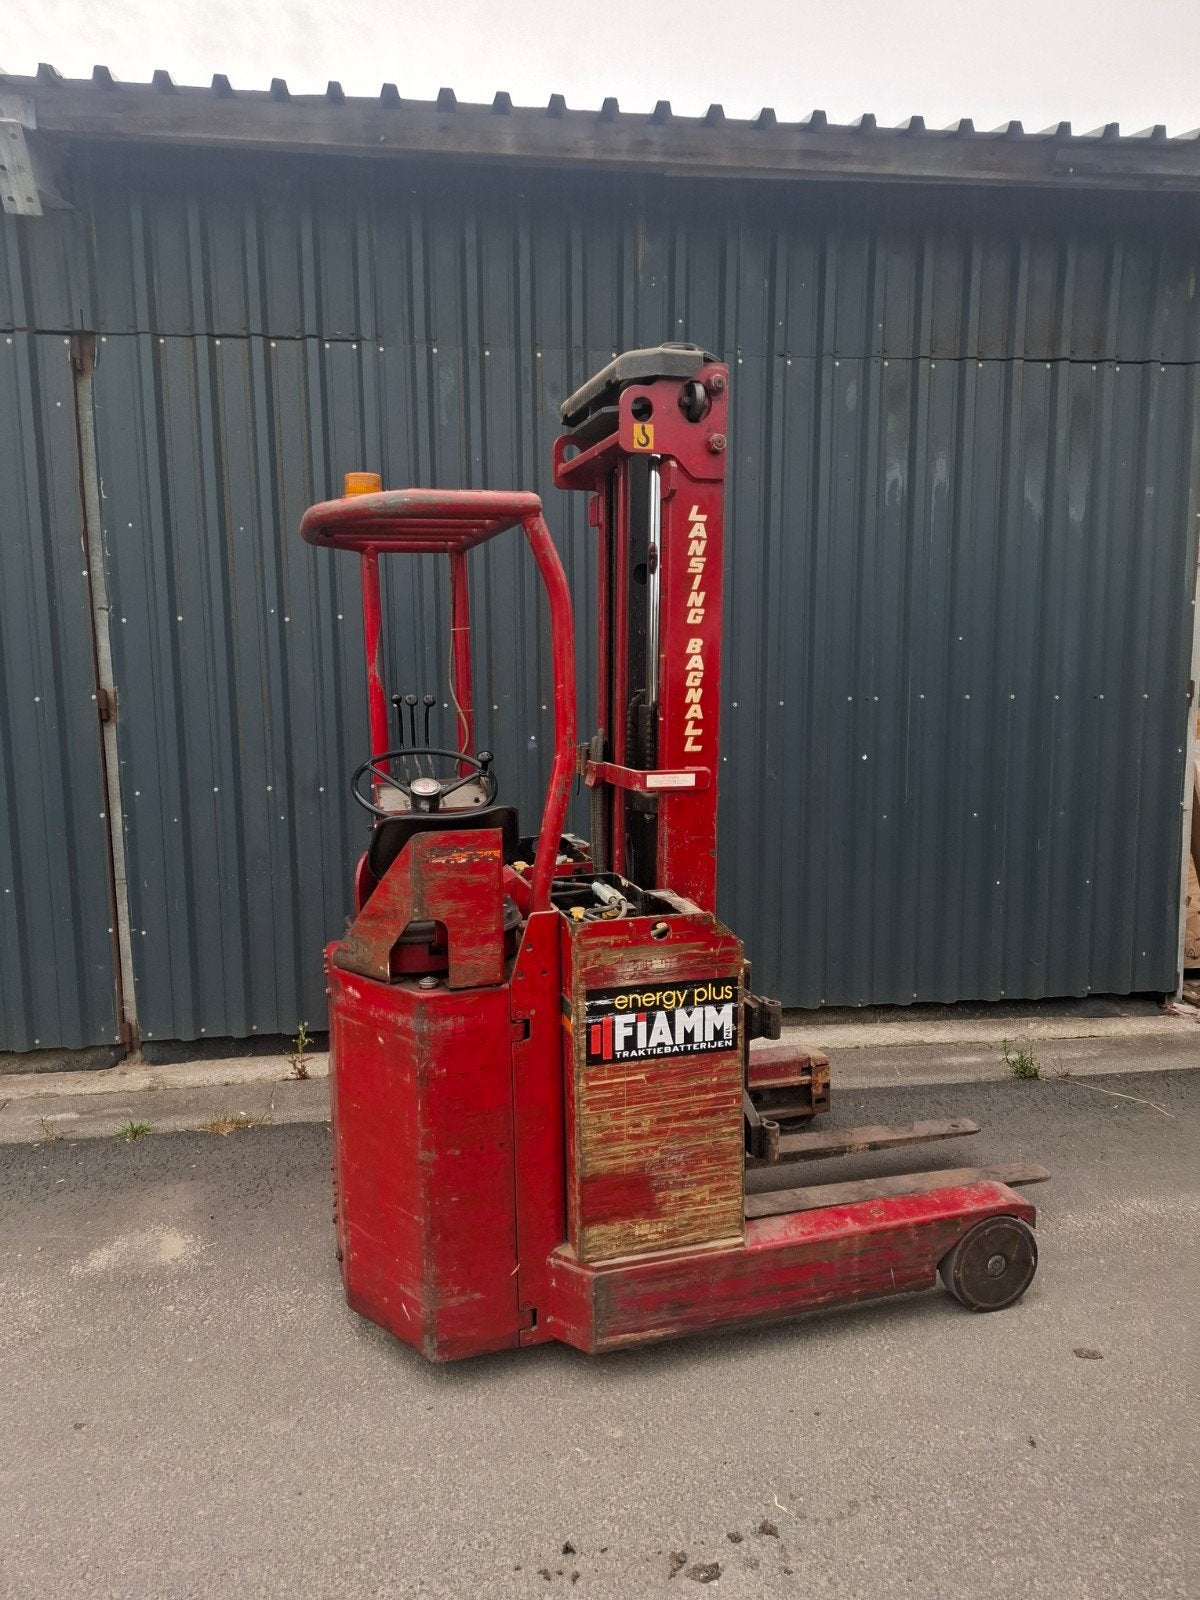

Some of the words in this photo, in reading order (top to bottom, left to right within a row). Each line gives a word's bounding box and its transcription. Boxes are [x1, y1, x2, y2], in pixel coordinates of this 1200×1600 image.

[687, 505, 708, 624] LANSING
[684, 638, 704, 752] BAGNALL
[614, 989, 688, 1010] energy
[694, 983, 733, 1006] plus
[615, 1040, 733, 1059] TRAKTIEBATTERIJEN
